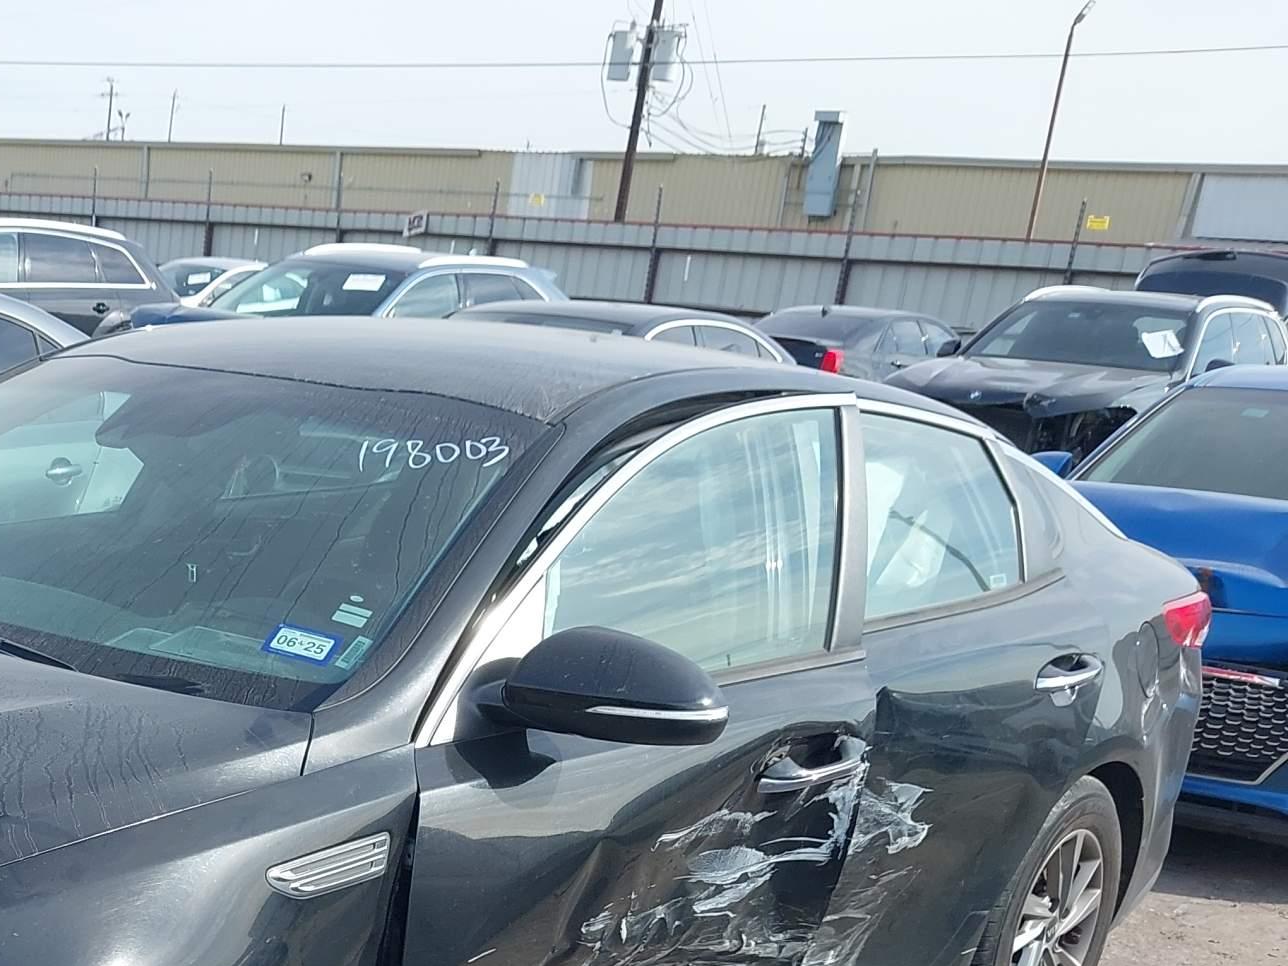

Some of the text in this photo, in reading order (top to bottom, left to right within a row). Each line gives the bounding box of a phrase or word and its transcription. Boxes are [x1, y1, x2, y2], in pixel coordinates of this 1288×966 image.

[359, 436, 510, 473] 198003
[276, 635, 298, 648] 06
[304, 641, 326, 655] 25
